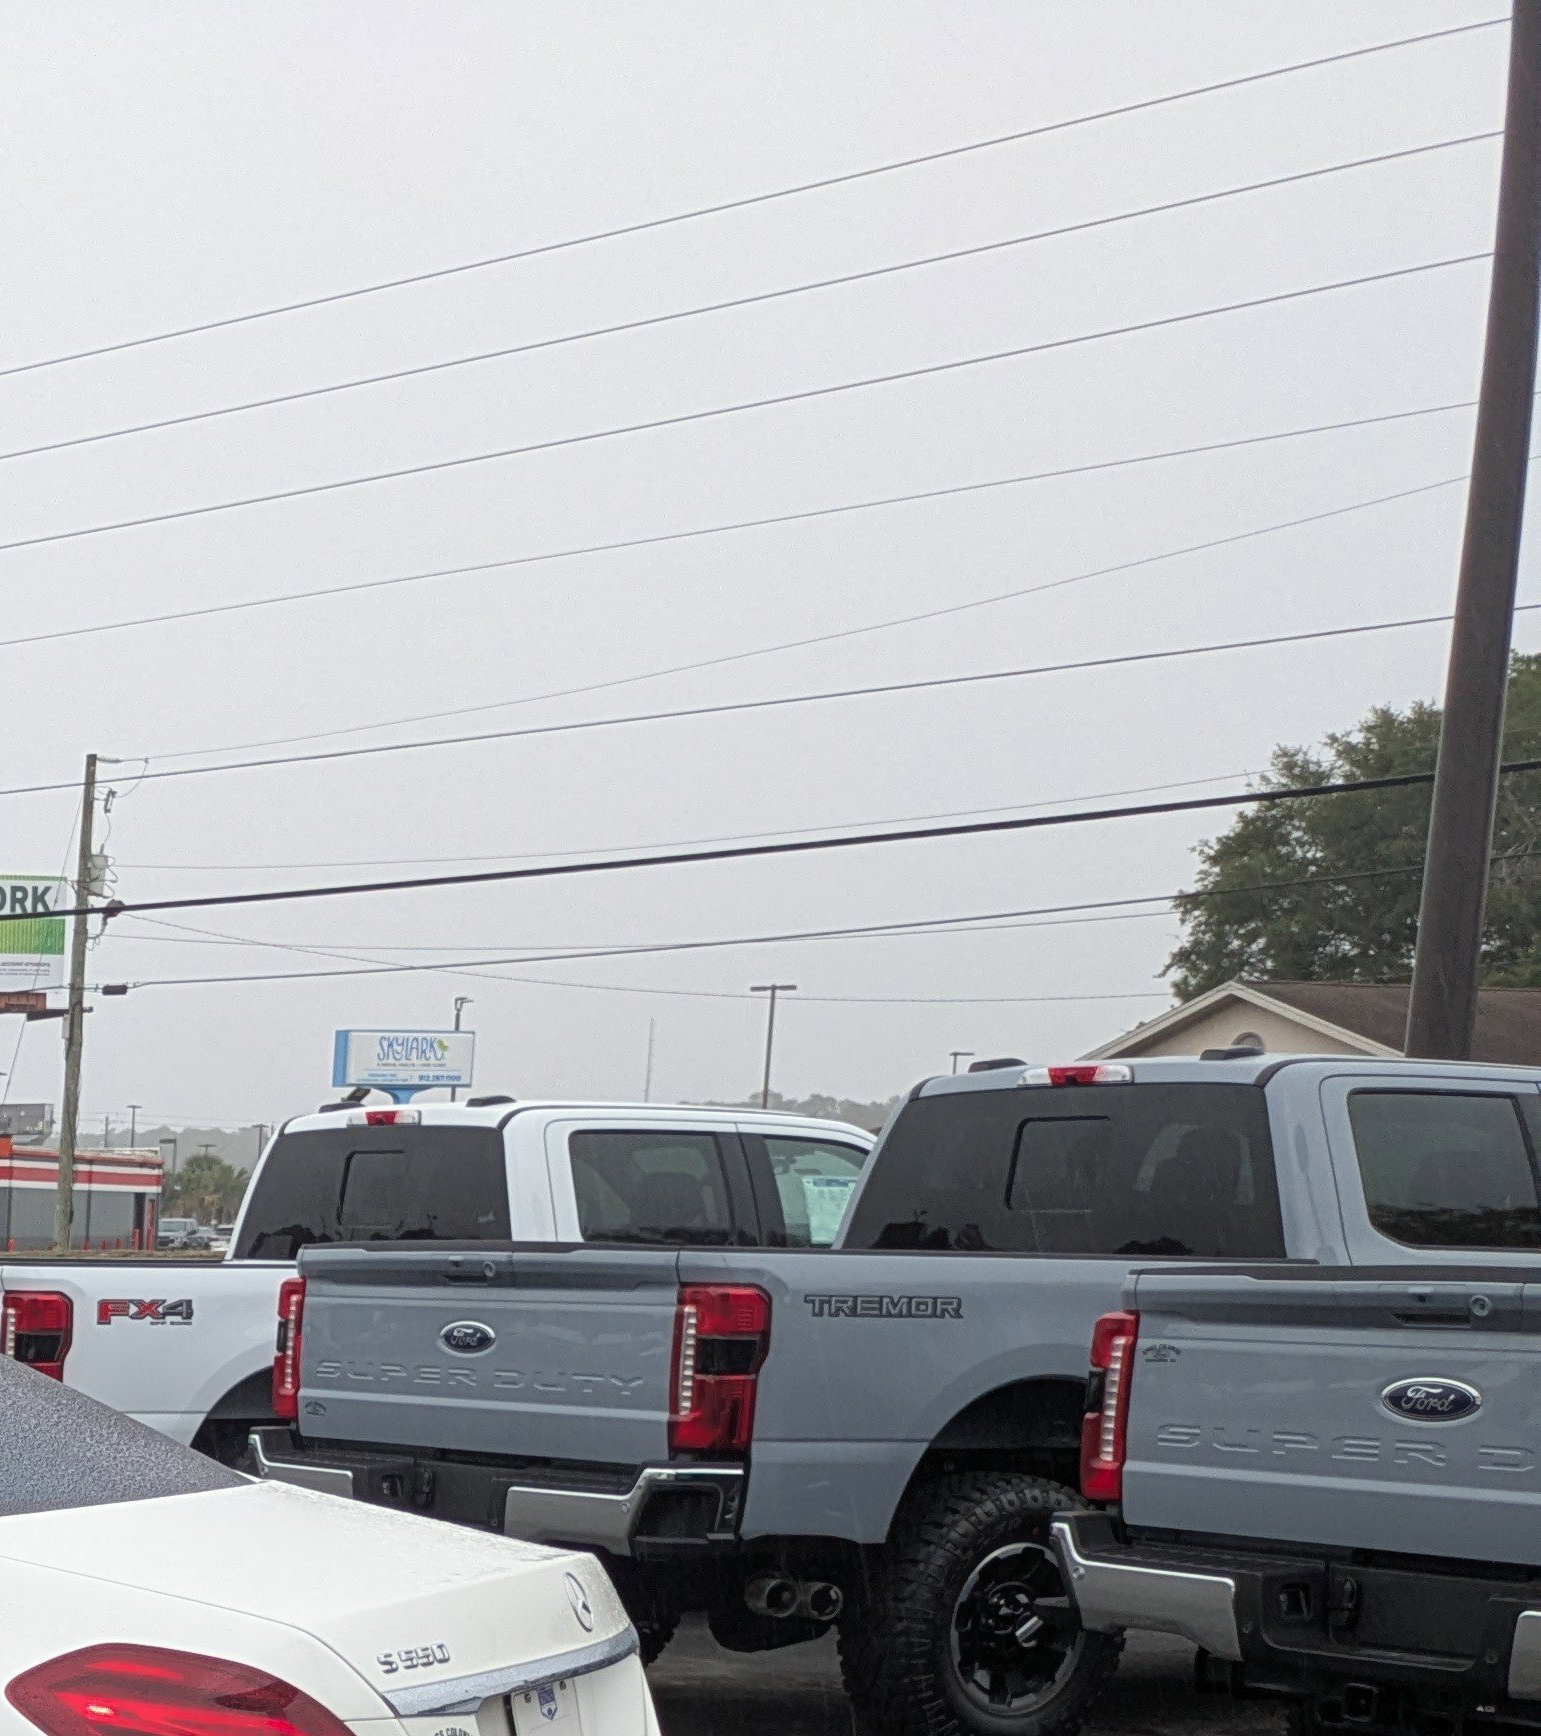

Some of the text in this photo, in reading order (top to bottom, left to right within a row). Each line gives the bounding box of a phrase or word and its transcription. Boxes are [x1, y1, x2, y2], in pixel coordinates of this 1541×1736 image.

[377, 1036, 444, 1061] SKYLARK
[96, 1299, 194, 1325] FX4
[803, 1294, 964, 1320] TREMOR
[316, 1360, 644, 1396] SUPER DUTY
[1400, 1385, 1457, 1412] Ford
[1157, 1423, 1447, 1467] SUPER
[376, 1642, 451, 1674] S 550
